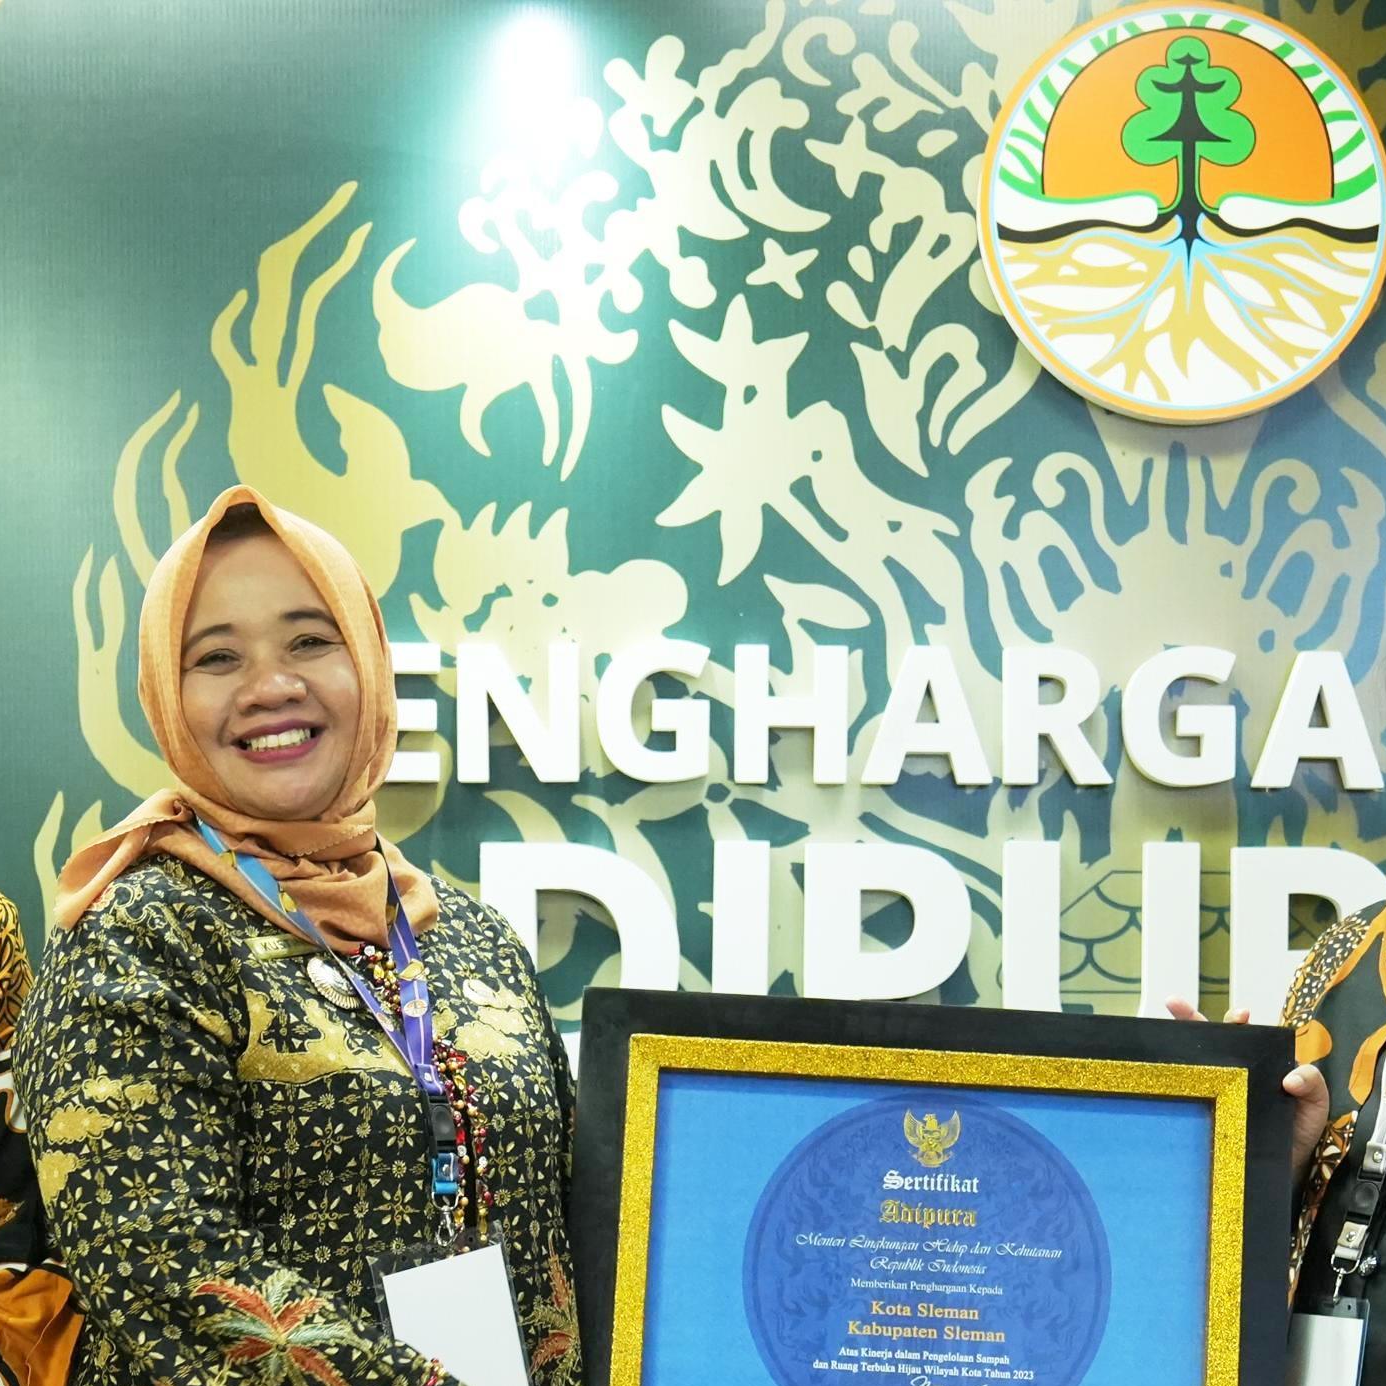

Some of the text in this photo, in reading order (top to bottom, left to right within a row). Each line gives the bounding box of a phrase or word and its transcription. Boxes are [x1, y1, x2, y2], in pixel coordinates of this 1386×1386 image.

[882, 1169, 979, 1193] Sertifikat
[879, 1199, 977, 1229] Adipura
[795, 1232, 1063, 1258] Menteri Lingkungan Hidup dan Kehutanan
[870, 1256, 986, 1275] Republik Indonesia
[851, 1278, 1003, 1296] Memberikan Penghargaan Kepada
[871, 1300, 979, 1320] Kota Sleman
[848, 1320, 1006, 1343] Kabupaten Sleman
[838, 1347, 1010, 1366] Atas Kinerja dalam Pengelolaan Sampah
[813, 1359, 1034, 1380] dan Ruang Terbuka Hijau Wilayah Kota Tahun 2023
